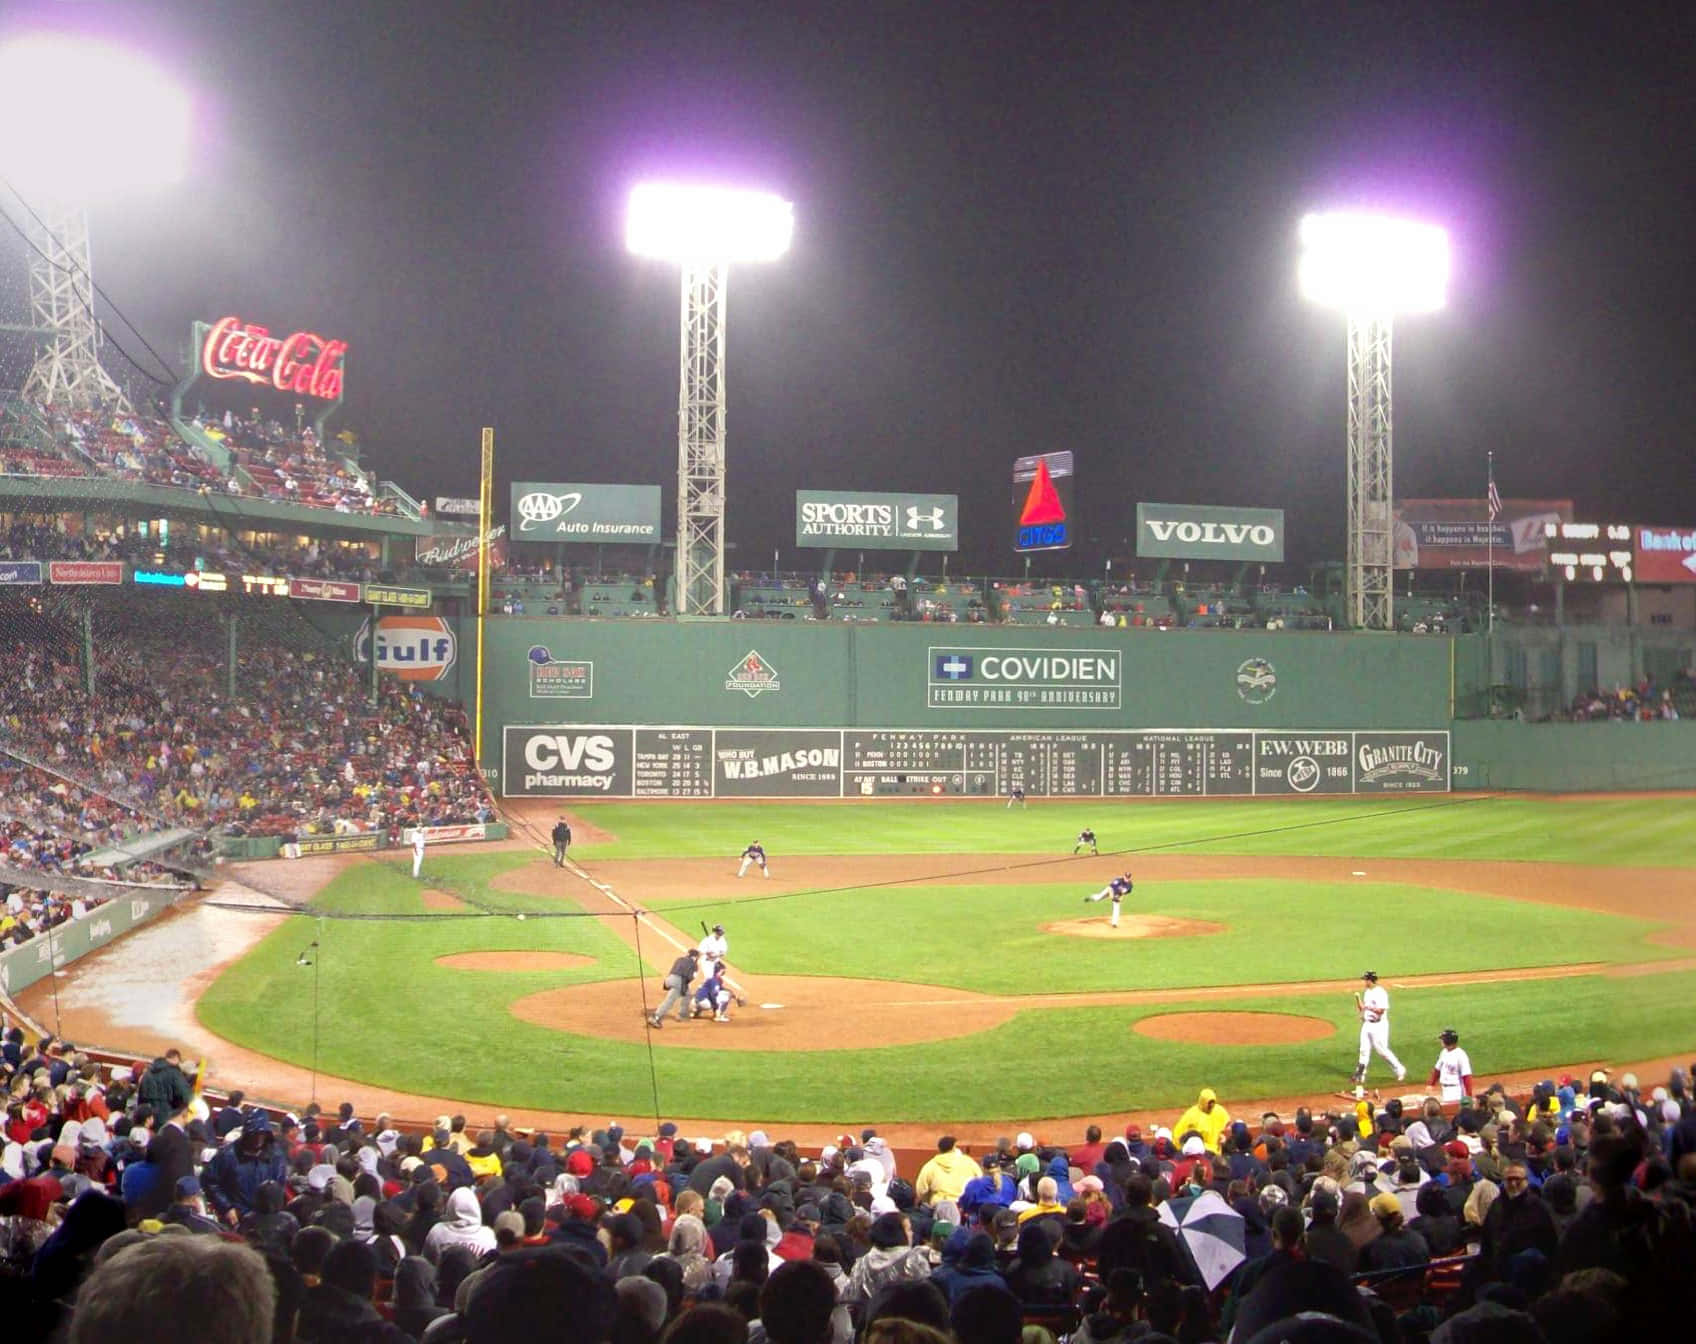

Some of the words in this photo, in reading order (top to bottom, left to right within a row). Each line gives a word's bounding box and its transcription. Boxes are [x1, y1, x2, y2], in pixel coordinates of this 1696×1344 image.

[523, 496, 559, 517] AAA
[802, 502, 892, 524] SPORTS
[556, 522, 589, 533] Auto
[592, 522, 654, 534] Insurance
[802, 523, 892, 537] AUTHORITY
[1019, 524, 1067, 547] CITGO
[1145, 520, 1275, 545] VOLVO
[1640, 530, 1681, 550] Bank
[360, 636, 449, 661] Gulf
[981, 657, 1115, 680] COVIDIEN
[525, 735, 615, 771] CVS
[1296, 740, 1348, 755] WEBB
[525, 772, 613, 790] pharmacy
[1260, 767, 1282, 778] Since
